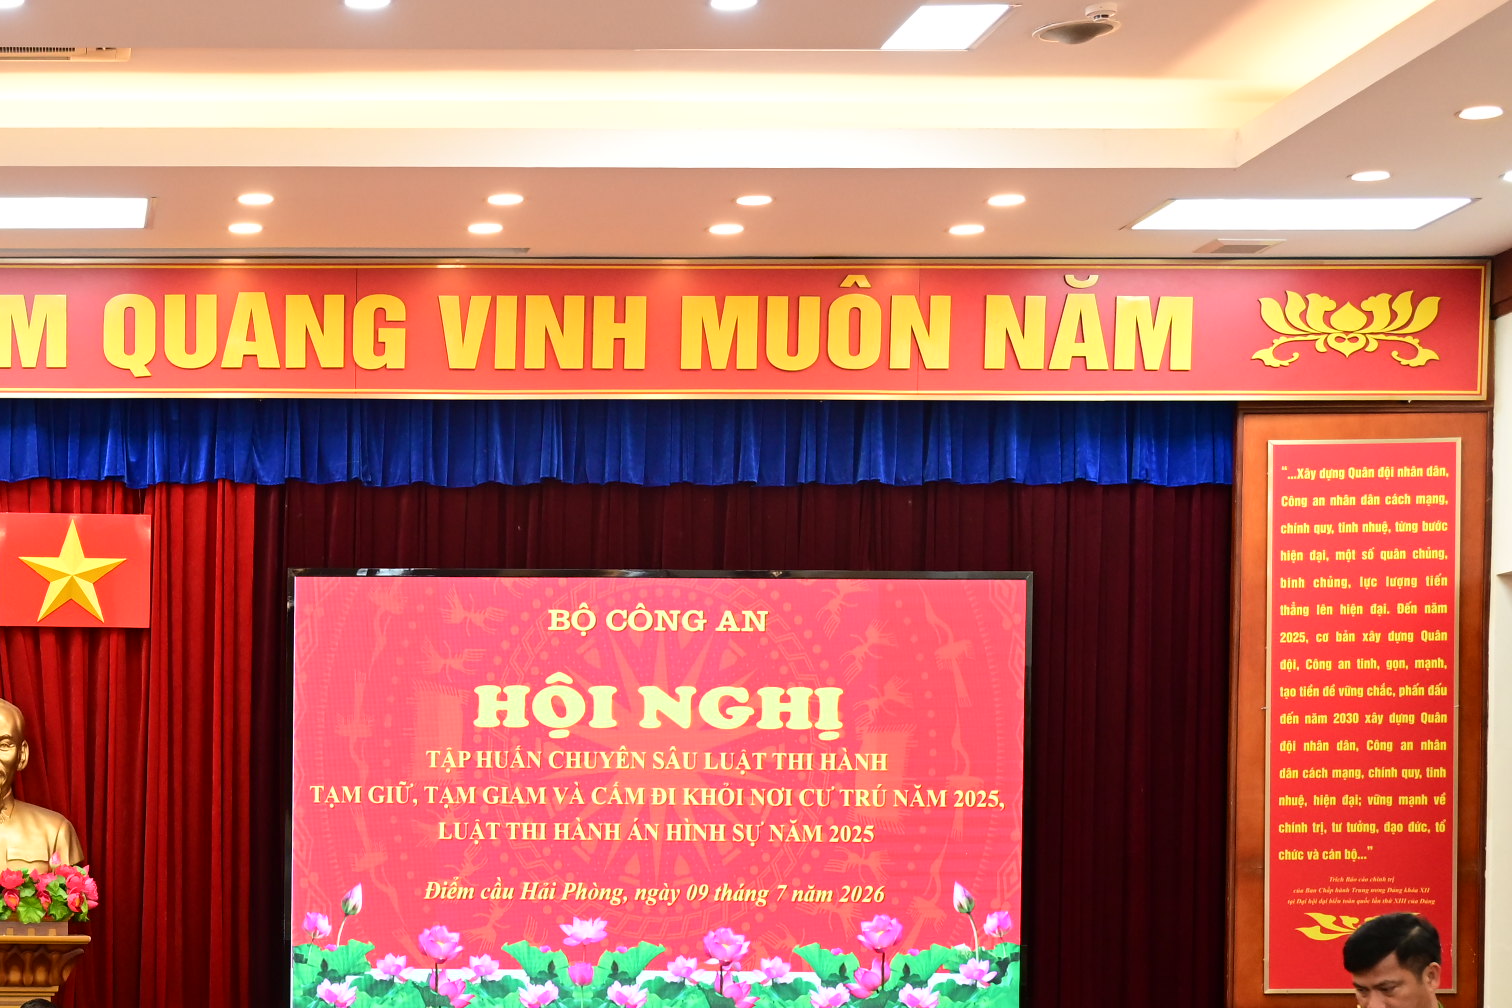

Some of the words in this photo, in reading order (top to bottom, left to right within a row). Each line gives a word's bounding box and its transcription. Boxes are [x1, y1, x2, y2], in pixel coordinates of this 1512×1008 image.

[105, 291, 406, 377] QUANG
[440, 295, 646, 369] VINH
[682, 274, 951, 371] MUÔN
[985, 274, 1192, 370] NĂM
[1282, 496, 1307, 507] Công
[1313, 497, 1325, 506] an
[1330, 495, 1356, 506] nhân
[1361, 494, 1380, 505] dân
[1385, 494, 1410, 504] cách
[1416, 495, 1448, 506] mạng,
[548, 602, 596, 636] BỘ
[606, 603, 707, 631] CÔNG
[716, 610, 768, 631] AN
[1280, 632, 1308, 643] 2025,
[1316, 633, 1328, 642] cơ
[1336, 630, 1355, 642] bản
[1363, 631, 1381, 642] xây
[1388, 631, 1414, 643] dựng
[1421, 630, 1447, 642] Quân
[474, 672, 618, 738] HỘI
[638, 686, 843, 740] NGHỊ
[1280, 712, 1299, 724] đến
[1305, 713, 1327, 724] năm
[1334, 713, 1359, 723] 2030
[1365, 712, 1383, 724] xây
[1390, 713, 1414, 725] dựng
[1421, 712, 1447, 724] Quân
[426, 747, 470, 773] TẬP
[476, 746, 541, 768] HUẤN
[549, 746, 646, 769] CHUYÊN
[653, 746, 698, 770] SÂU
[704, 750, 767, 774] LUẬT
[772, 753, 813, 770] THI
[820, 748, 888, 770] HÀNH
[310, 786, 362, 808] TẠM
[368, 781, 417, 806] GIỮ,
[424, 786, 476, 808] TẠM
[483, 786, 546, 804] GIAM
[553, 782, 584, 804] VÀ
[592, 782, 645, 804] CẤM
[651, 788, 676, 805] ĐI
[682, 783, 743, 806] KHỎI
[750, 787, 792, 806] NƠI
[799, 786, 834, 806] CƯ
[839, 784, 887, 807] TRÚ
[893, 784, 947, 807] NĂM
[954, 790, 1004, 809] 2025,
[438, 819, 500, 844] LUẬT
[506, 822, 546, 840] THI
[554, 818, 621, 840] HÀNH
[628, 818, 659, 840] ÁN
[667, 818, 726, 841] HÌNH
[733, 822, 764, 846] SỰ
[769, 820, 822, 842] NĂM
[830, 826, 874, 842] 2025
[424, 878, 474, 899] Điểm
[481, 878, 514, 899] cầu
[520, 882, 556, 900] Hải
[561, 882, 627, 905] Phòng,
[635, 883, 680, 906] ngày
[687, 884, 708, 900] 09
[714, 883, 769, 906] tháng
[778, 885, 787, 900] 7
[792, 885, 832, 902] năm
[839, 886, 884, 902] 2026
